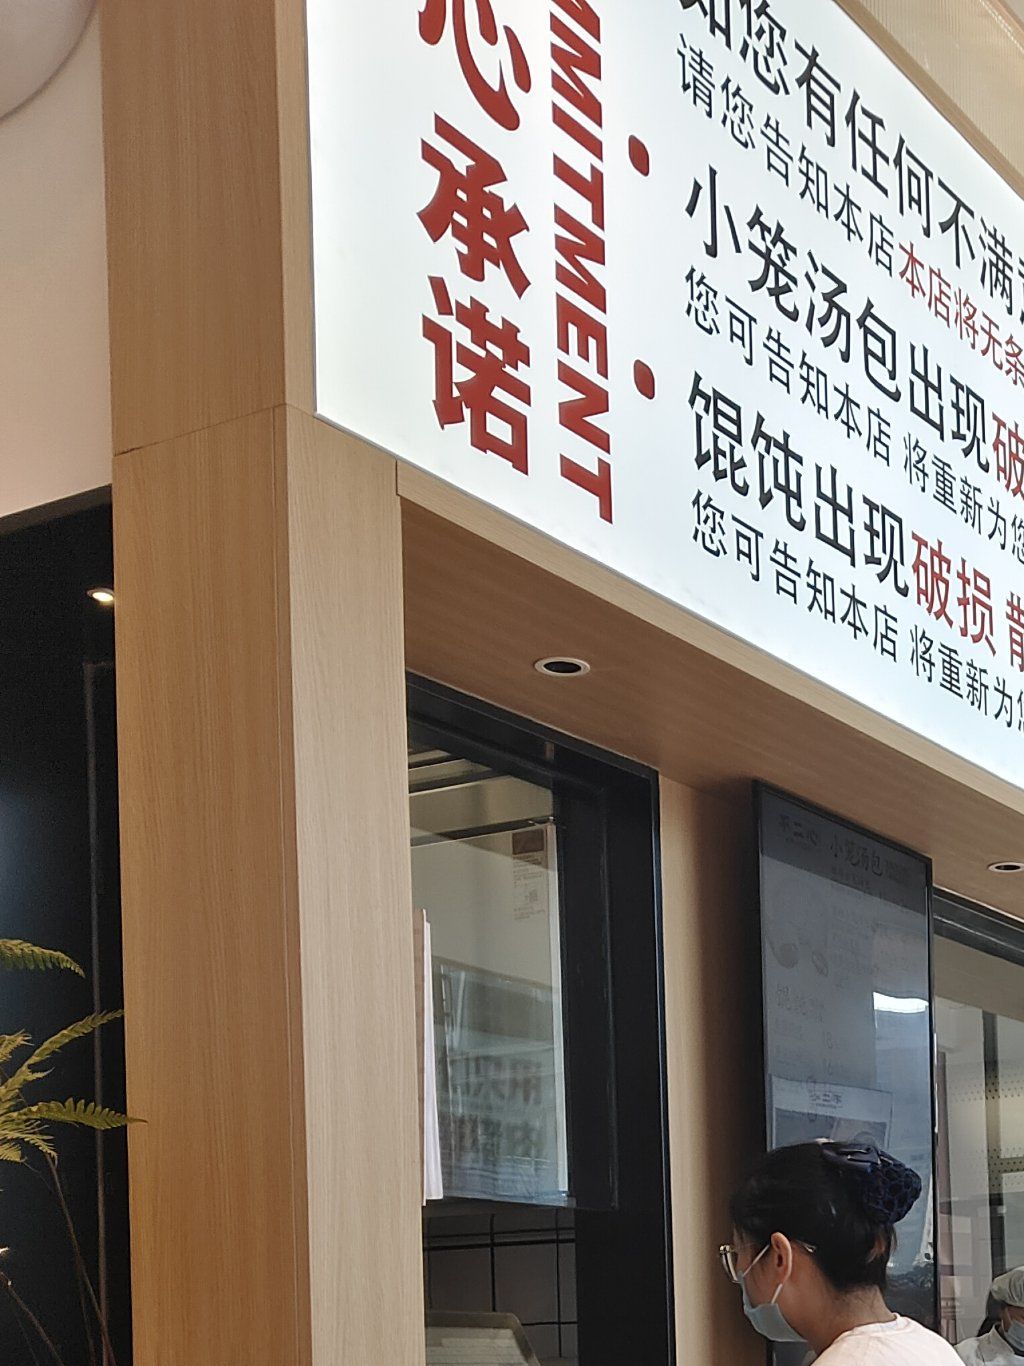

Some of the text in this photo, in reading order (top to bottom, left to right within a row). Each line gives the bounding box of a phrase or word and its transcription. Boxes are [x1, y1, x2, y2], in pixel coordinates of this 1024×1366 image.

[685, 265, 892, 468] 您可告知本店
[688, 370, 997, 658] 馄饨出现破损
[691, 489, 898, 663] 您可告知本店
